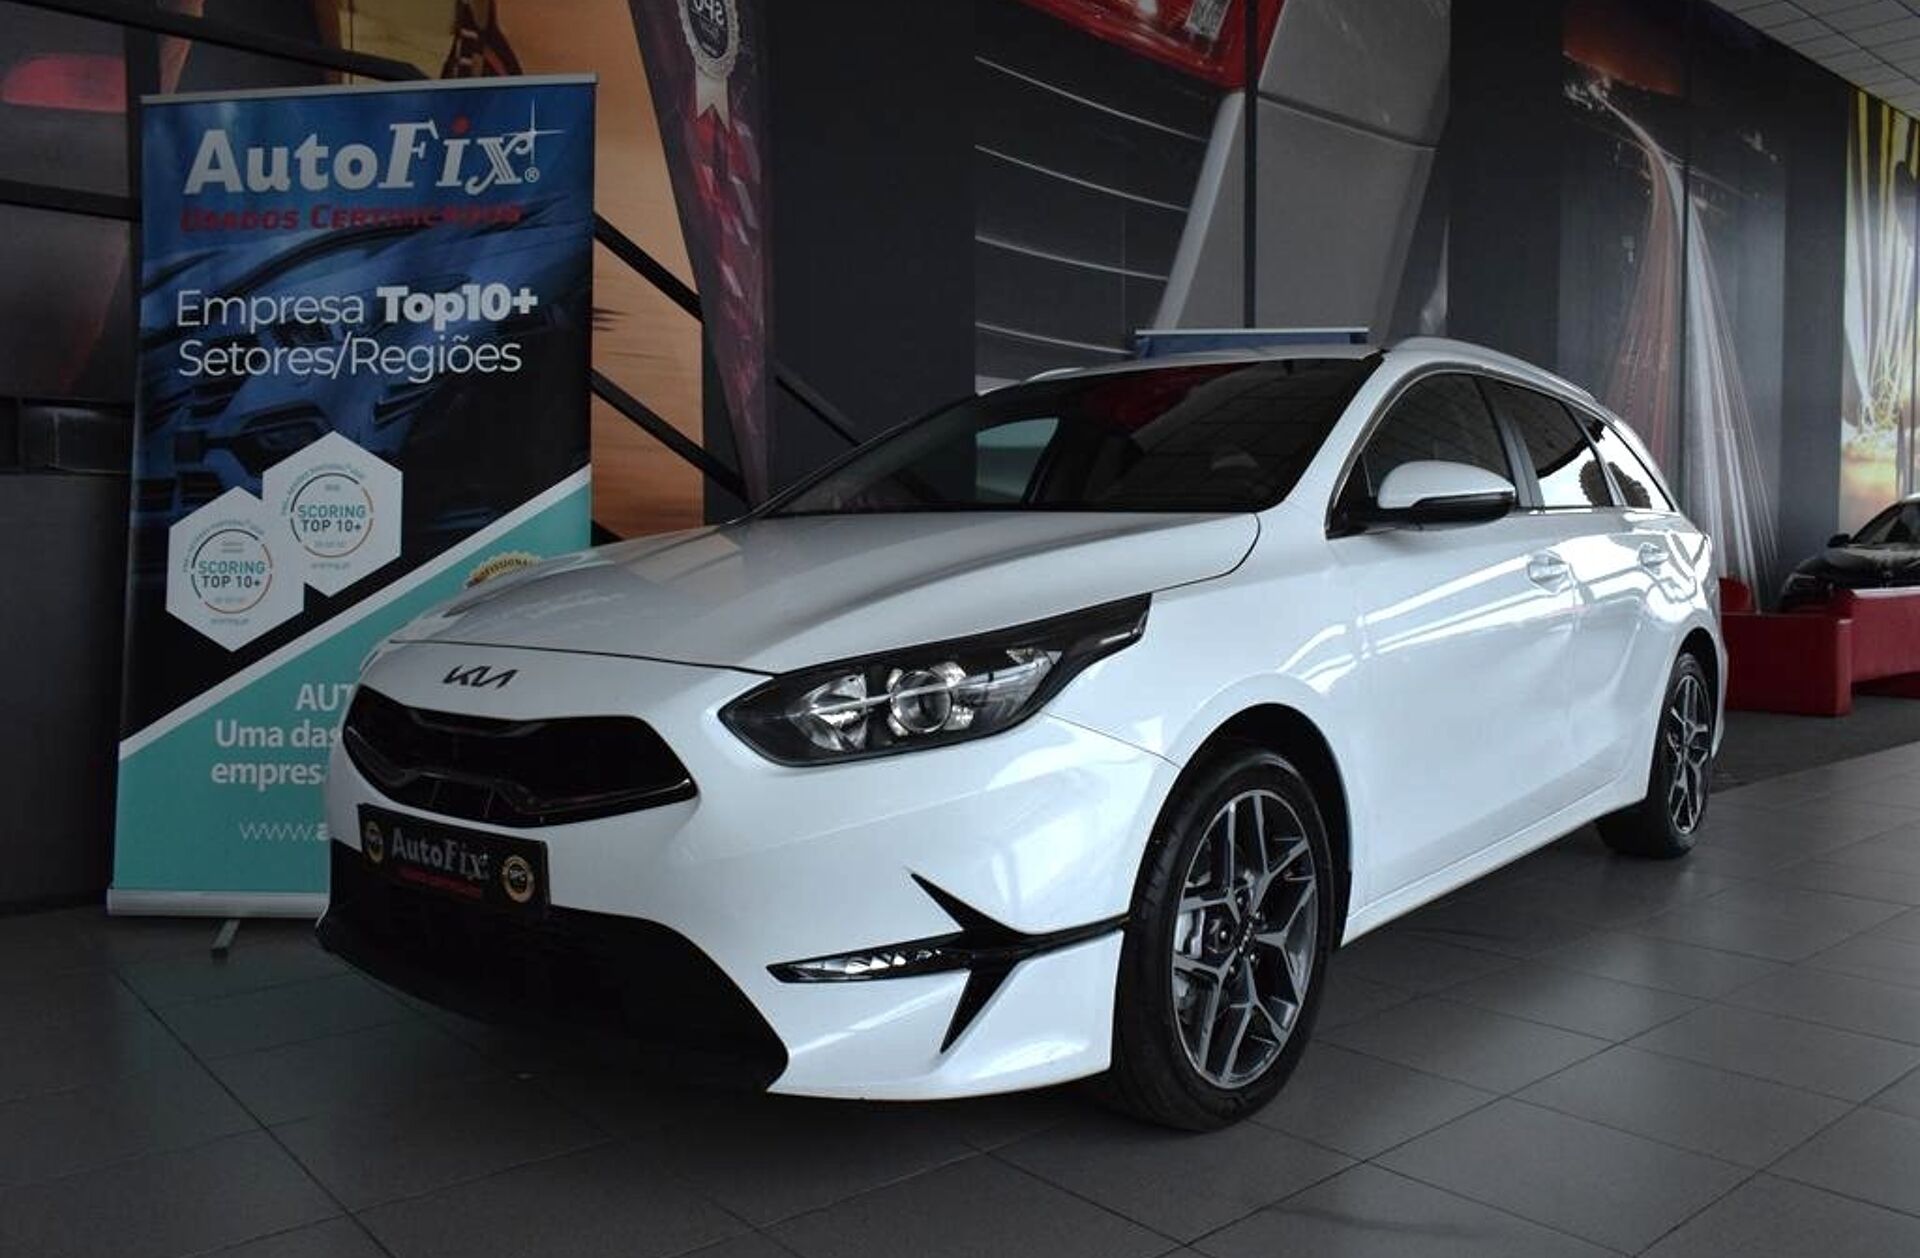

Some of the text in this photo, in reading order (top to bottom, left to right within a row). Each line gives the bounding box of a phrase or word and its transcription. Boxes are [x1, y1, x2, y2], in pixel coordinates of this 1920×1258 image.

[177, 282, 538, 332] Empresa Top10+
[179, 333, 522, 384] Setores/Regiões
[298, 504, 366, 519] SCORING
[302, 519, 361, 533] TOP 10+
[198, 560, 265, 574] SCORING
[202, 574, 261, 589] TOP 10+
[215, 718, 339, 748] Uma das
